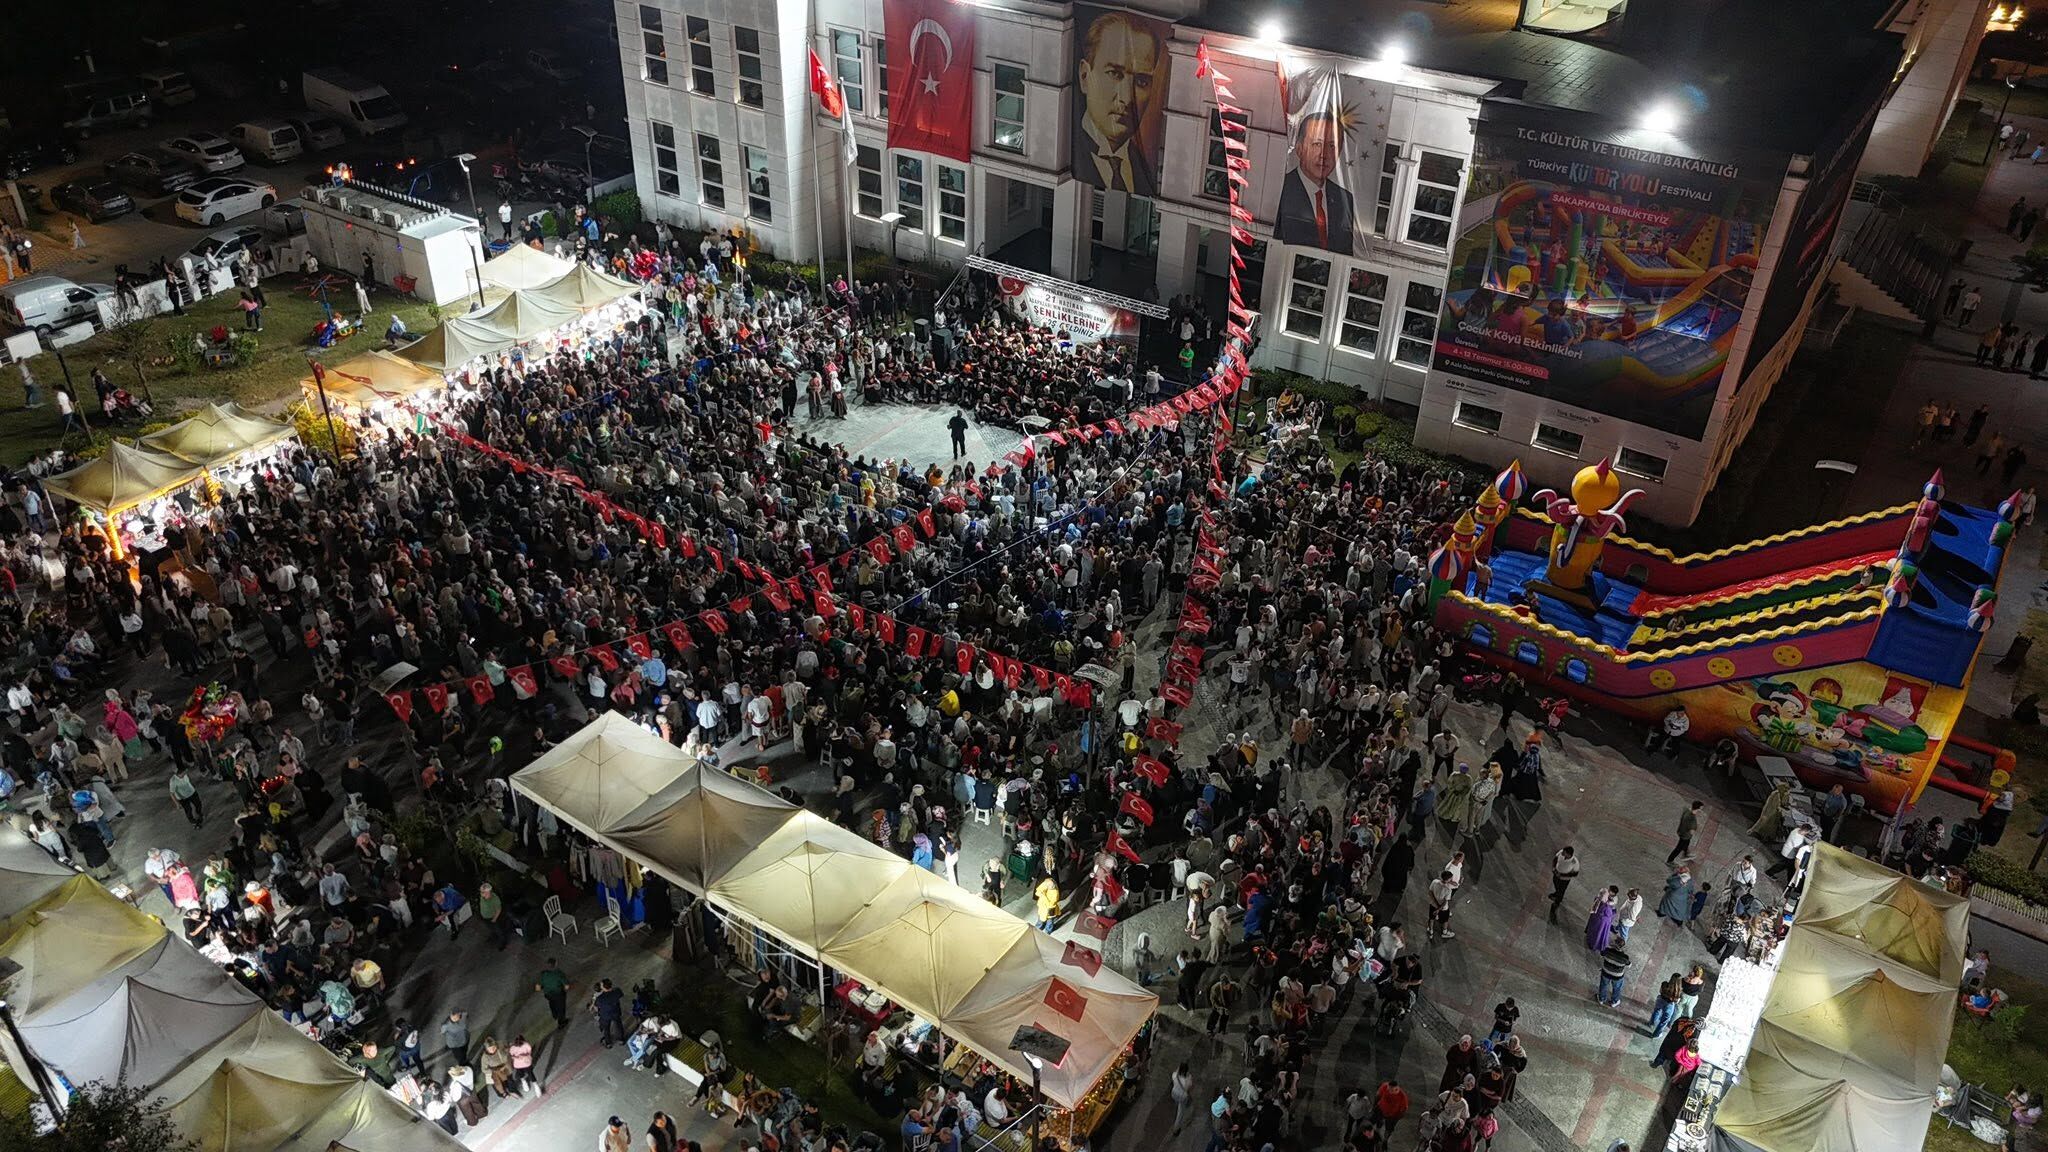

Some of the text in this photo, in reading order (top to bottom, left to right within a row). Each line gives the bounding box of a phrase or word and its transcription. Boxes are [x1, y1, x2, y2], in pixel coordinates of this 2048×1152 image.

[1517, 128, 1537, 141] T.C.
[1540, 131, 1589, 151] KÜLTÜR
[1592, 141, 1608, 155] VE
[1663, 156, 1739, 179] BAKANLIĞI
[1528, 158, 1569, 174] TÜRKİYE
[1660, 184, 1713, 202] FESTİVALİ
[1552, 194, 1611, 214] SAKARYA'DA
[1045, 294, 1056, 303] 21
[1033, 306, 1101, 332] ŞENLİKLERİNE
[1457, 320, 1583, 360] Çocuk Köyü Etkinlikleri
